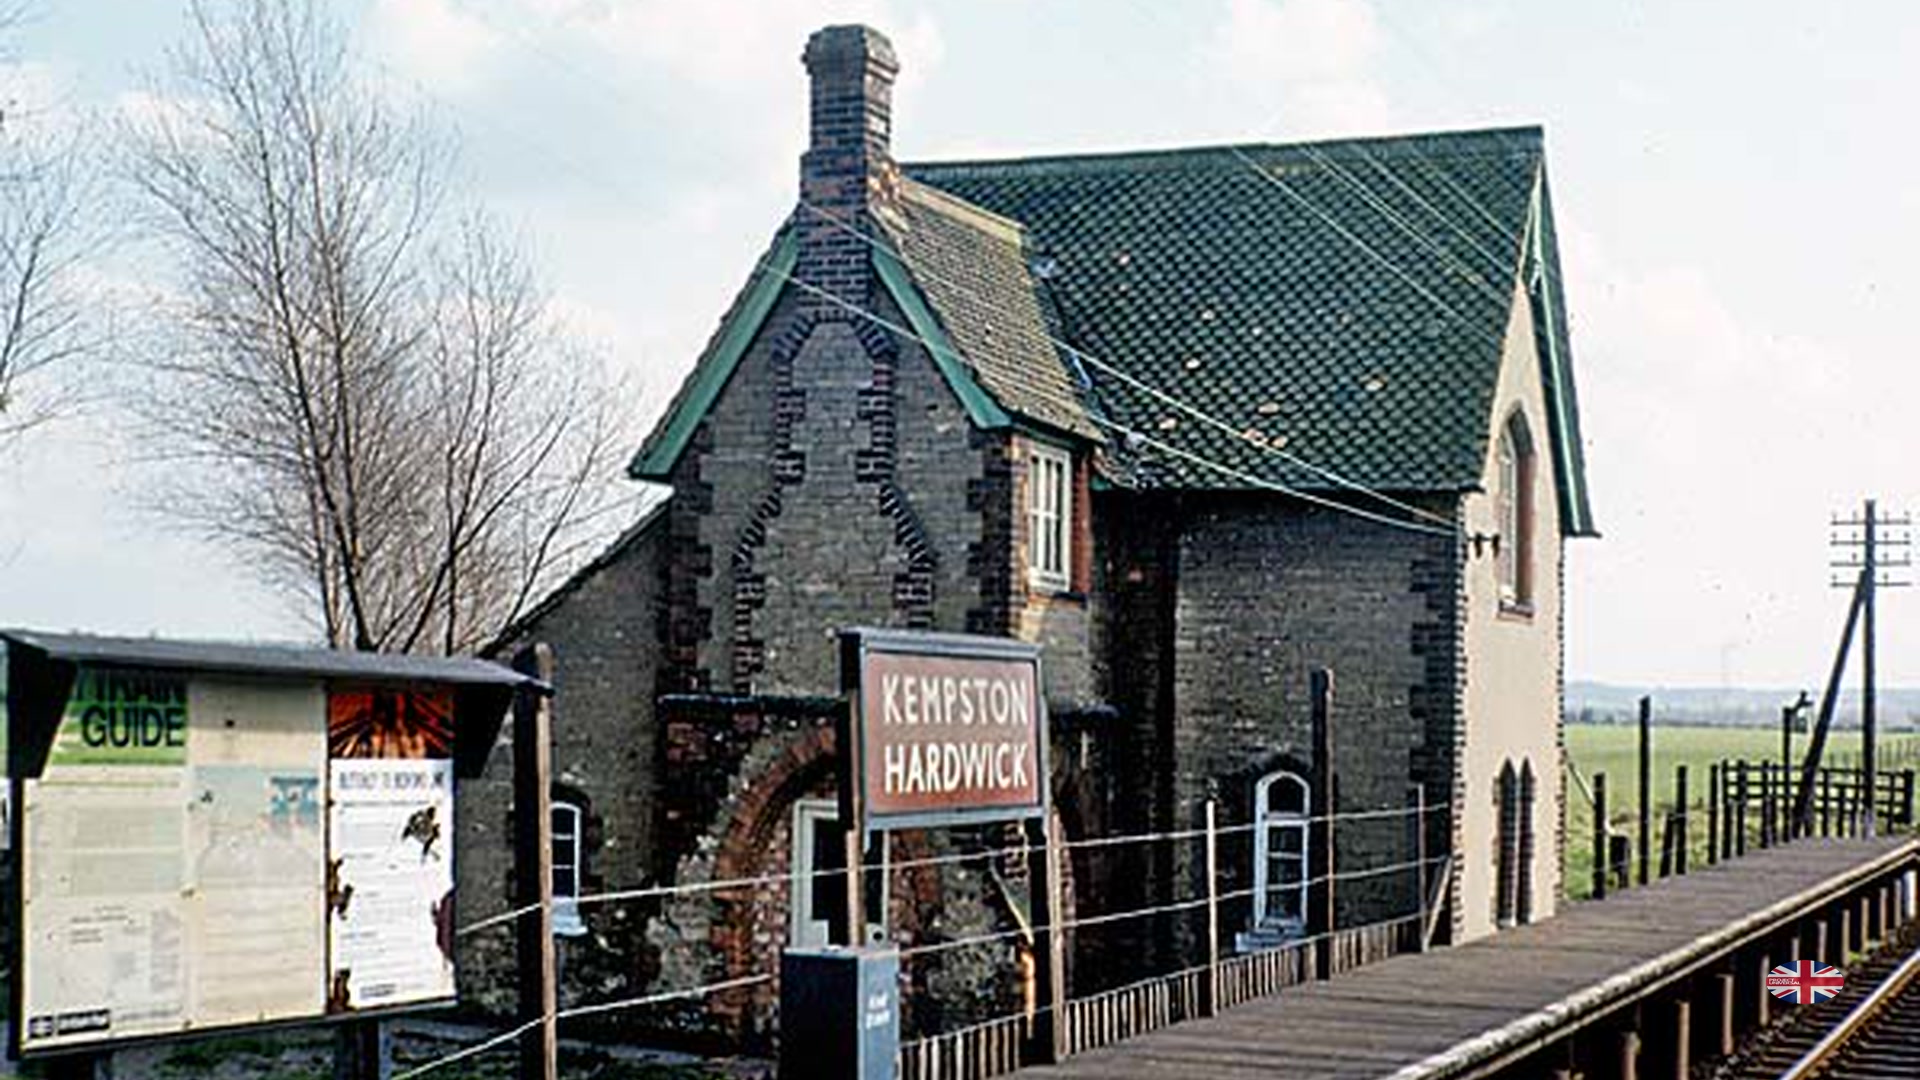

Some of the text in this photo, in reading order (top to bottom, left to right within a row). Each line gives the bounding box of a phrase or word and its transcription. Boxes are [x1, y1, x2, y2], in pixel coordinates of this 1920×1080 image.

[882, 673, 1028, 725] KEMPSTON
[81, 705, 185, 748] GUIDE
[884, 742, 1028, 793] HARDWICK
